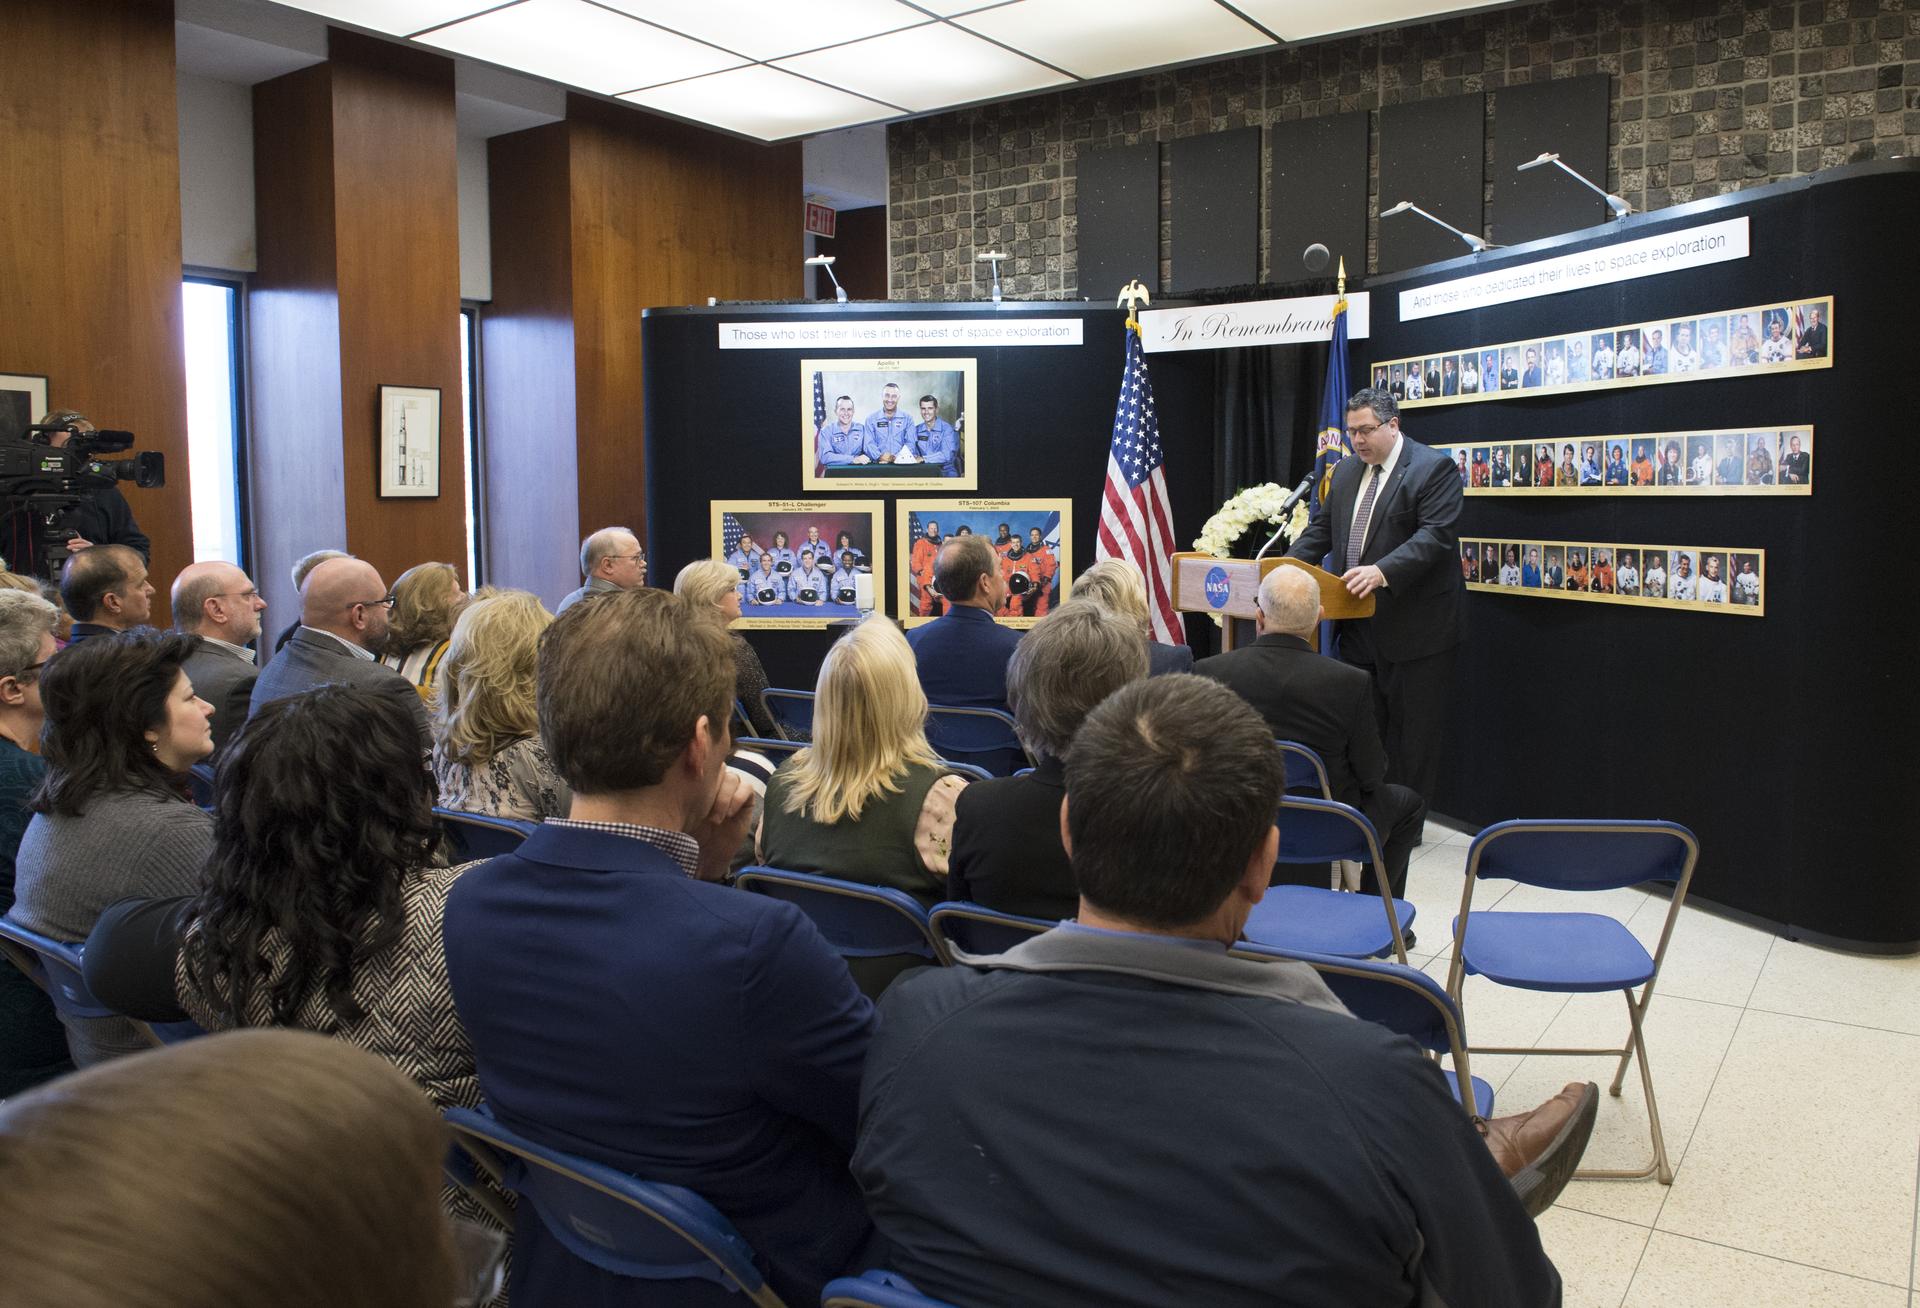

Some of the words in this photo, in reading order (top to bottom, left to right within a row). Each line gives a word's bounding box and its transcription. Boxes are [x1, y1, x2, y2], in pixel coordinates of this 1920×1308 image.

[809, 205, 834, 234] EXIT
[1413, 295, 1432, 309] And
[1434, 289, 1459, 305] those
[1462, 286, 1482, 299] who
[1485, 272, 1536, 296] dedicated
[1539, 267, 1562, 284] their
[1566, 263, 1591, 278] lives
[1594, 259, 1606, 272] to
[1610, 251, 1648, 271] space
[1651, 233, 1726, 262] exploration
[732, 329, 768, 340] Those
[771, 329, 796, 340] who
[799, 329, 819, 340] lost
[823, 328, 848, 339] their
[852, 328, 877, 339] lives
[880, 328, 891, 338] in
[894, 328, 913, 338] the
[916, 327, 949, 340] quest
[952, 326, 964, 337] of
[967, 328, 1002, 339] space
[1006, 325, 1070, 339] exploration
[1161, 315, 1193, 343] In
[1201, 311, 1336, 340] Remembranc
[1207, 582, 1229, 593] NASA
